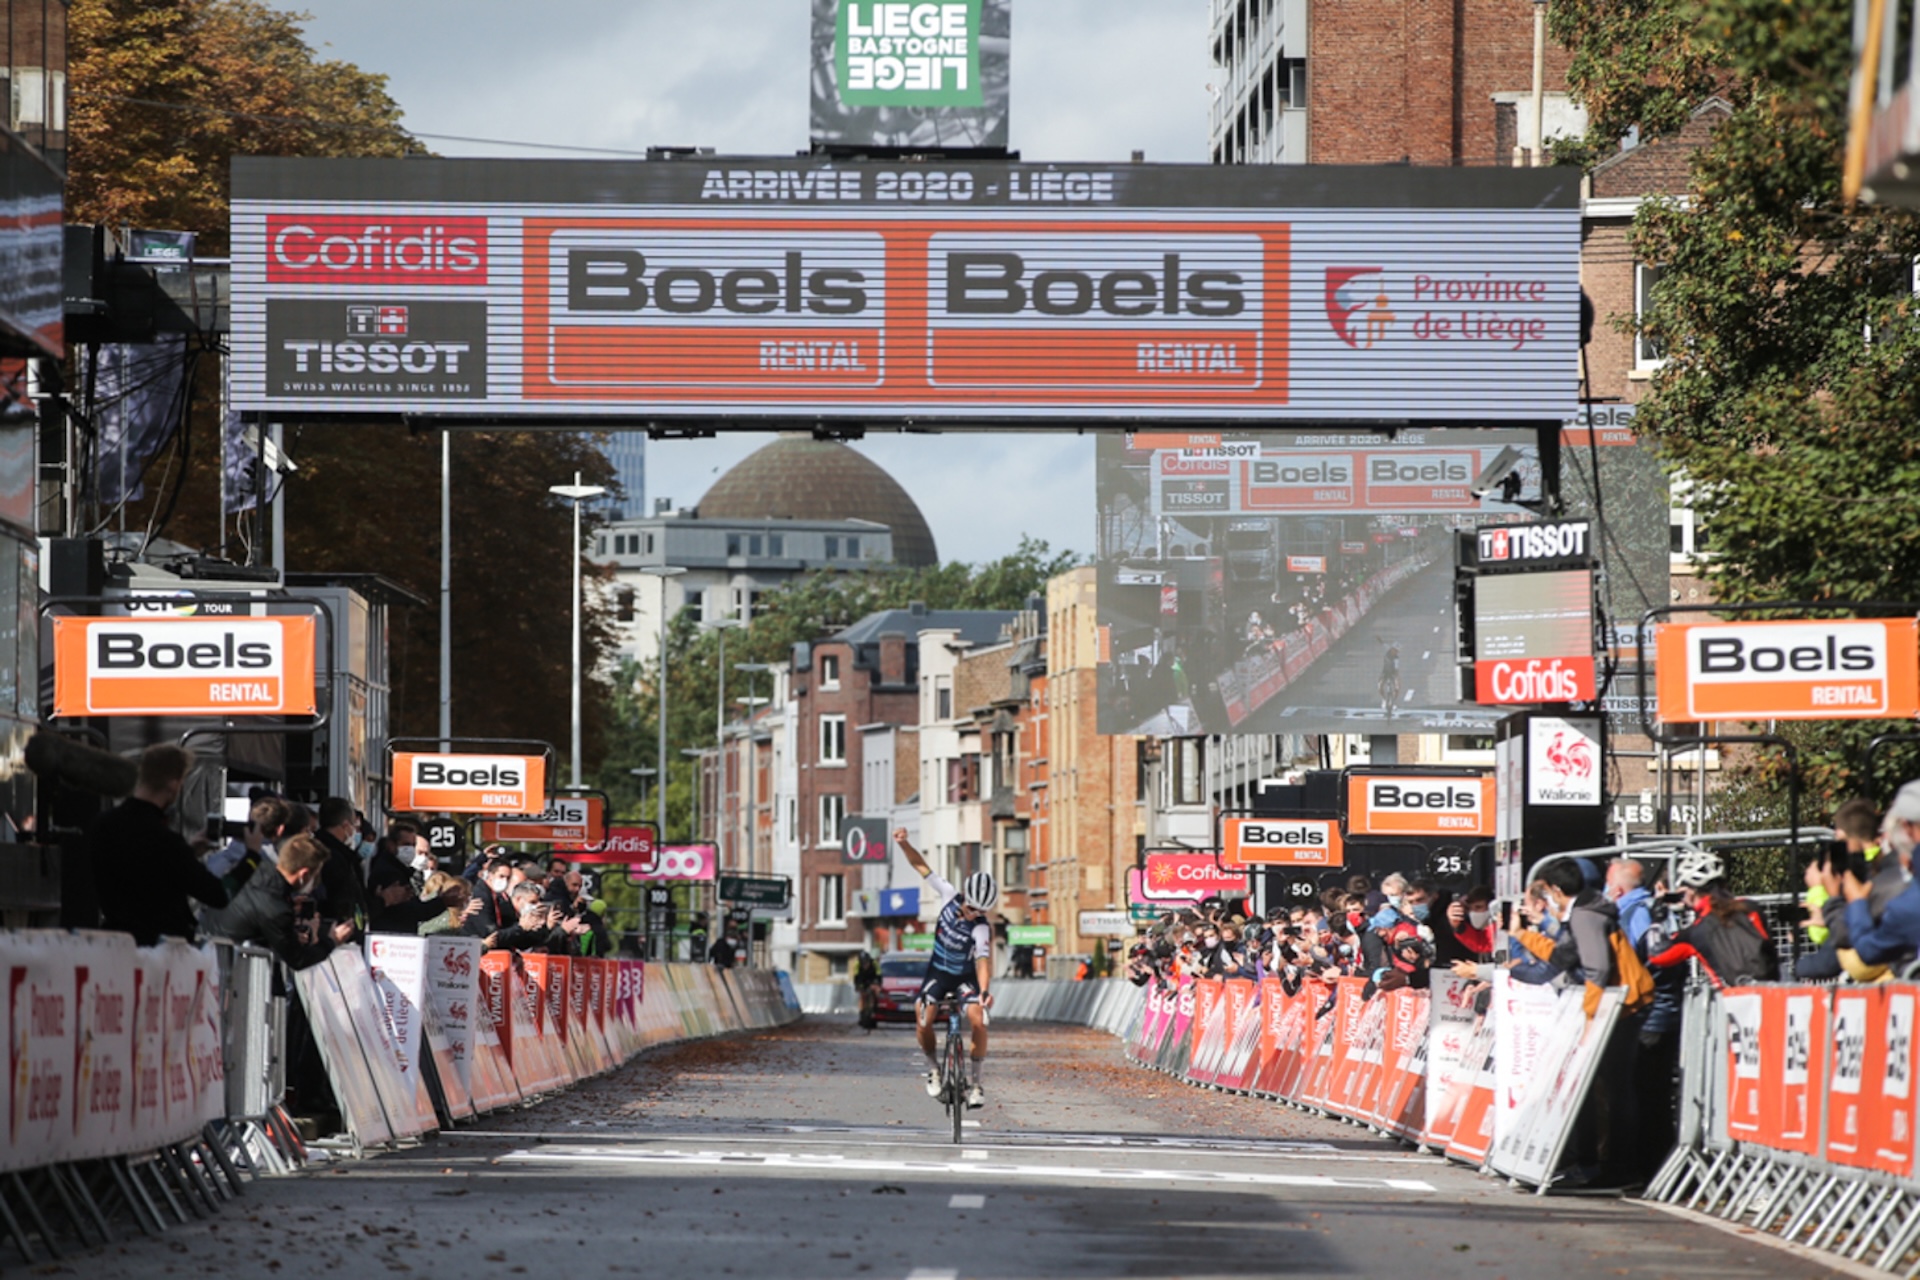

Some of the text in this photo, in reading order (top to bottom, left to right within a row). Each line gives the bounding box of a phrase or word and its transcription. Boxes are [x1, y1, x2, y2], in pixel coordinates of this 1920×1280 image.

[848, 4, 968, 36] LIEGE
[848, 38, 968, 55] BASTOGNE
[701, 165, 861, 200] ARRIVÉE
[875, 171, 974, 200] 2020
[1009, 165, 1114, 201] LIÈGE
[274, 225, 480, 272] Cofidis
[568, 249, 867, 314] Boels
[946, 252, 1245, 316] Boels
[1414, 271, 1546, 301] Province
[1413, 311, 1452, 340] de
[284, 341, 470, 374] TISSOT
[760, 341, 867, 371] RENTAL
[1137, 343, 1244, 373] RENTAL
[1602, 432, 1632, 442] RENTAL
[1205, 445, 1257, 457] TISSOT
[1253, 461, 1347, 482] Boels
[1372, 459, 1467, 481] Boels
[1167, 492, 1225, 504] TISSOT
[1509, 522, 1589, 559] TISSOT
[204, 603, 233, 614] TOUR
[97, 632, 272, 669] Boels
[1700, 635, 1875, 673] Boels
[1492, 659, 1579, 700] Cofidis
[210, 683, 272, 702] RENTAL
[1811, 685, 1878, 705] RENTAL
[417, 762, 520, 786] Boels
[481, 794, 520, 806] RENTAL
[1373, 786, 1476, 808] Boels
[1539, 788, 1592, 801] Wallonie
[1438, 816, 1475, 828] RENTAL
[1613, 804, 1654, 822] LES
[429, 827, 456, 848] 25
[1243, 826, 1324, 845] Boels
[1294, 851, 1324, 860] RENTAL
[1436, 856, 1461, 873] 25
[1291, 883, 1313, 896] 50
